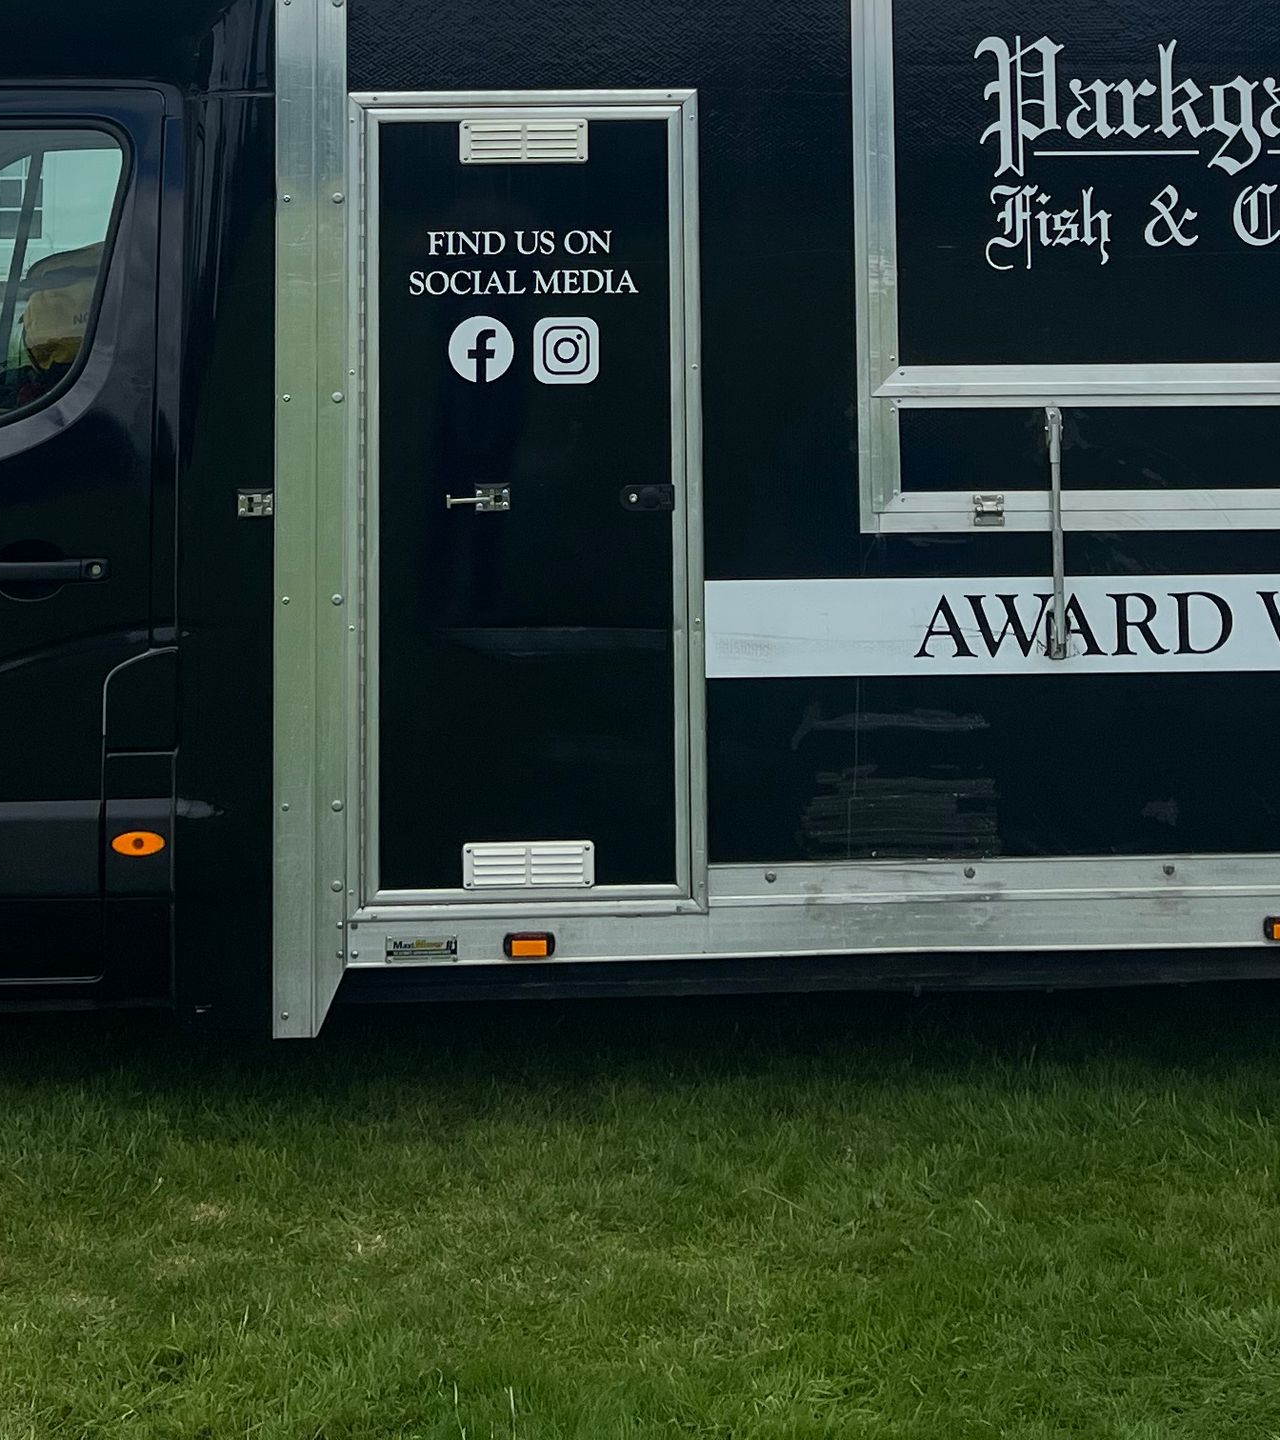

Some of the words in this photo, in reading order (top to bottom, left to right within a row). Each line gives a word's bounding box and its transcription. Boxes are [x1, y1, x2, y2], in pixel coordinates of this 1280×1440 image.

[428, 231, 505, 256] FIND
[514, 230, 555, 256] US
[564, 229, 612, 255] ON
[985, 184, 1112, 270] Fish
[1144, 184, 1199, 247] &
[409, 270, 526, 296] SOCIAL
[533, 269, 638, 295] MEDIA
[914, 590, 1234, 658] AWARD
